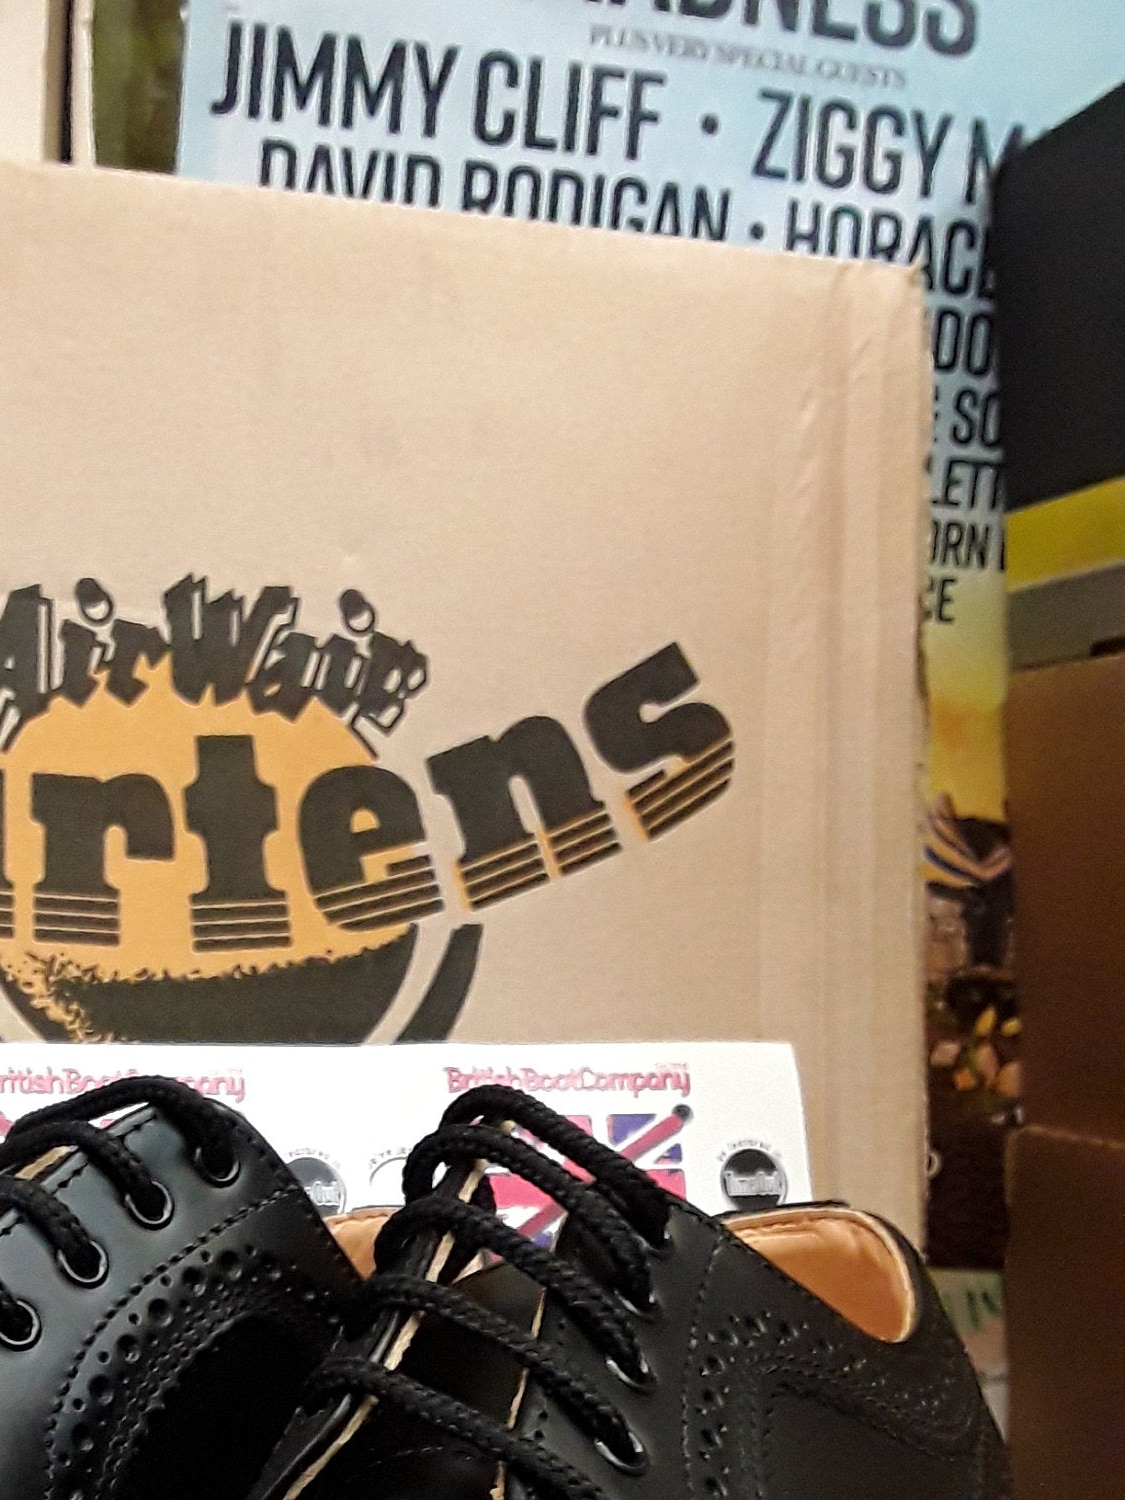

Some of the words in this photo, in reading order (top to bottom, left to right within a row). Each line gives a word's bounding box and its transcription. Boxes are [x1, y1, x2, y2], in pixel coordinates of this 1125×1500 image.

[211, 20, 462, 138] JIMMY
[473, 48, 668, 162] CLIFF
[751, 87, 954, 200] ZIGGY
[258, 138, 444, 209] DAVID
[460, 159, 732, 241] RODIGAN
